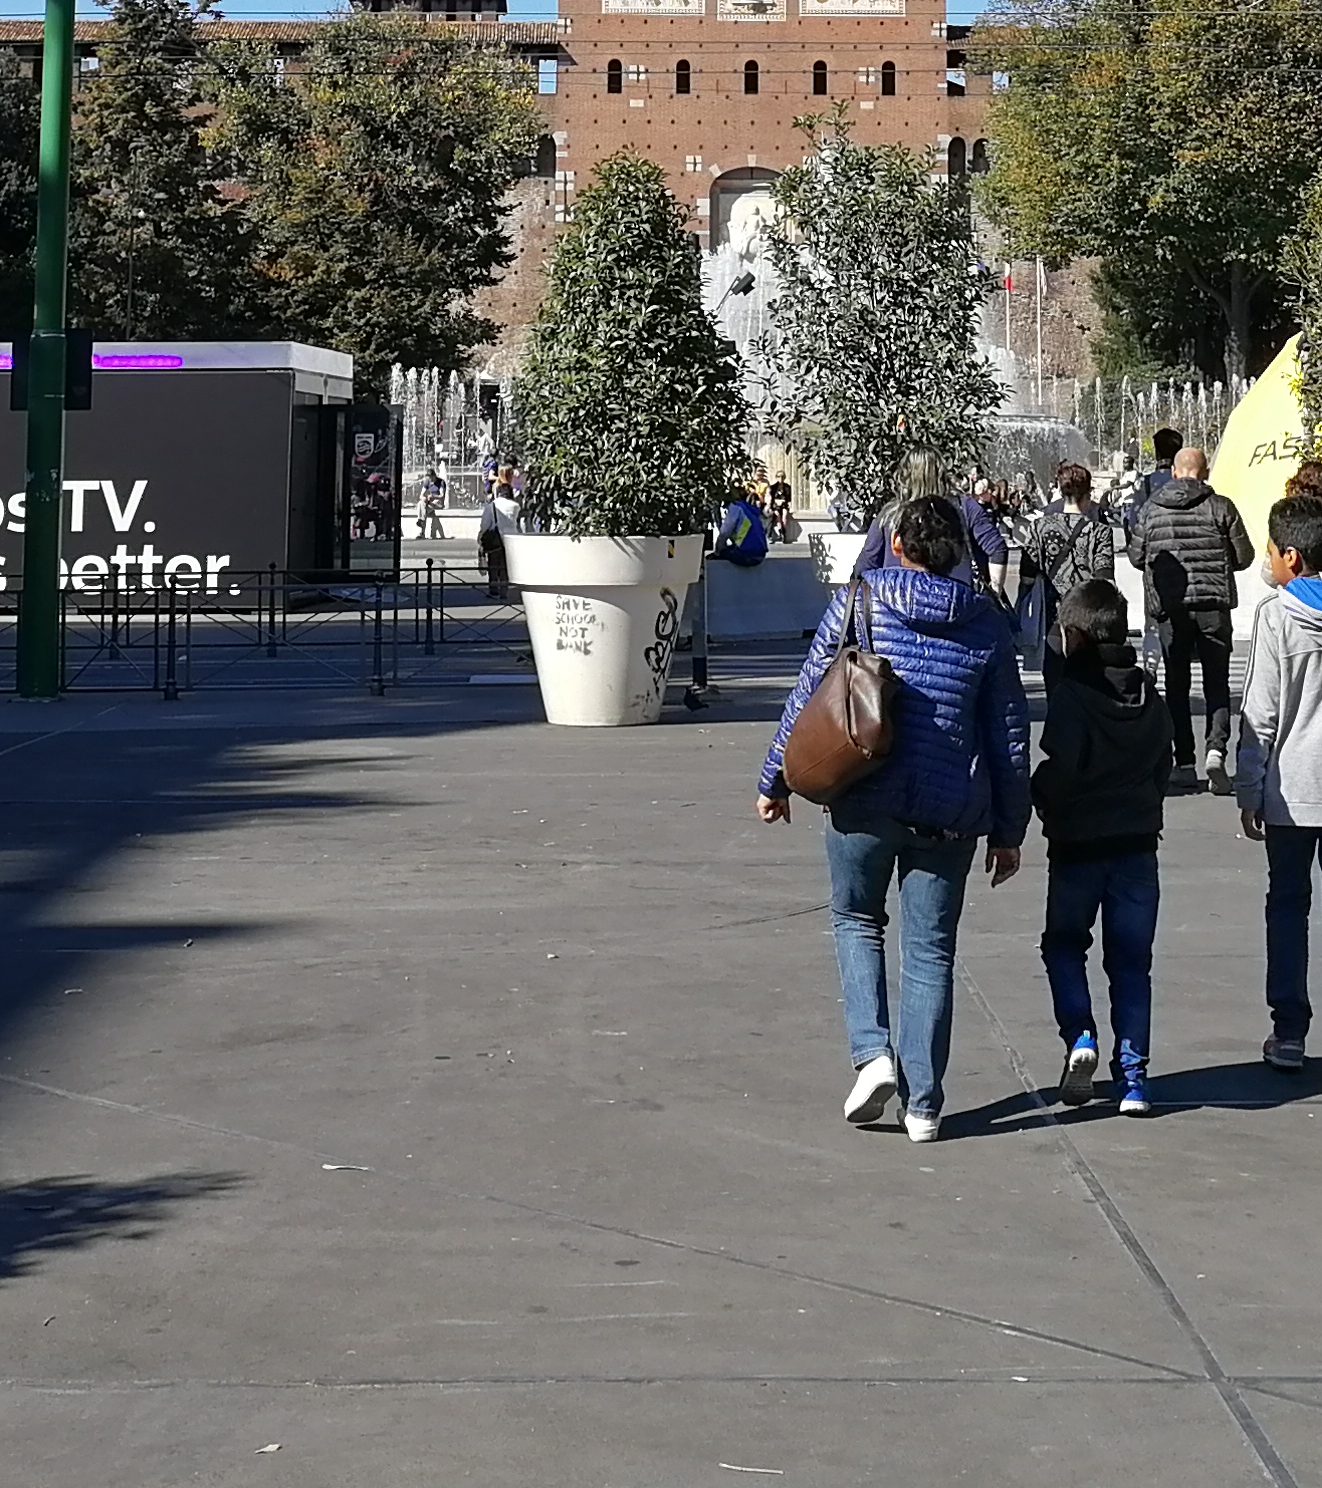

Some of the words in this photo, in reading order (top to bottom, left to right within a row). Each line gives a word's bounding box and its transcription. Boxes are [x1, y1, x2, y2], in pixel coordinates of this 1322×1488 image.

[62, 479, 156, 533] TV.
[555, 594, 592, 611] SAVE
[559, 626, 588, 639] NOT
